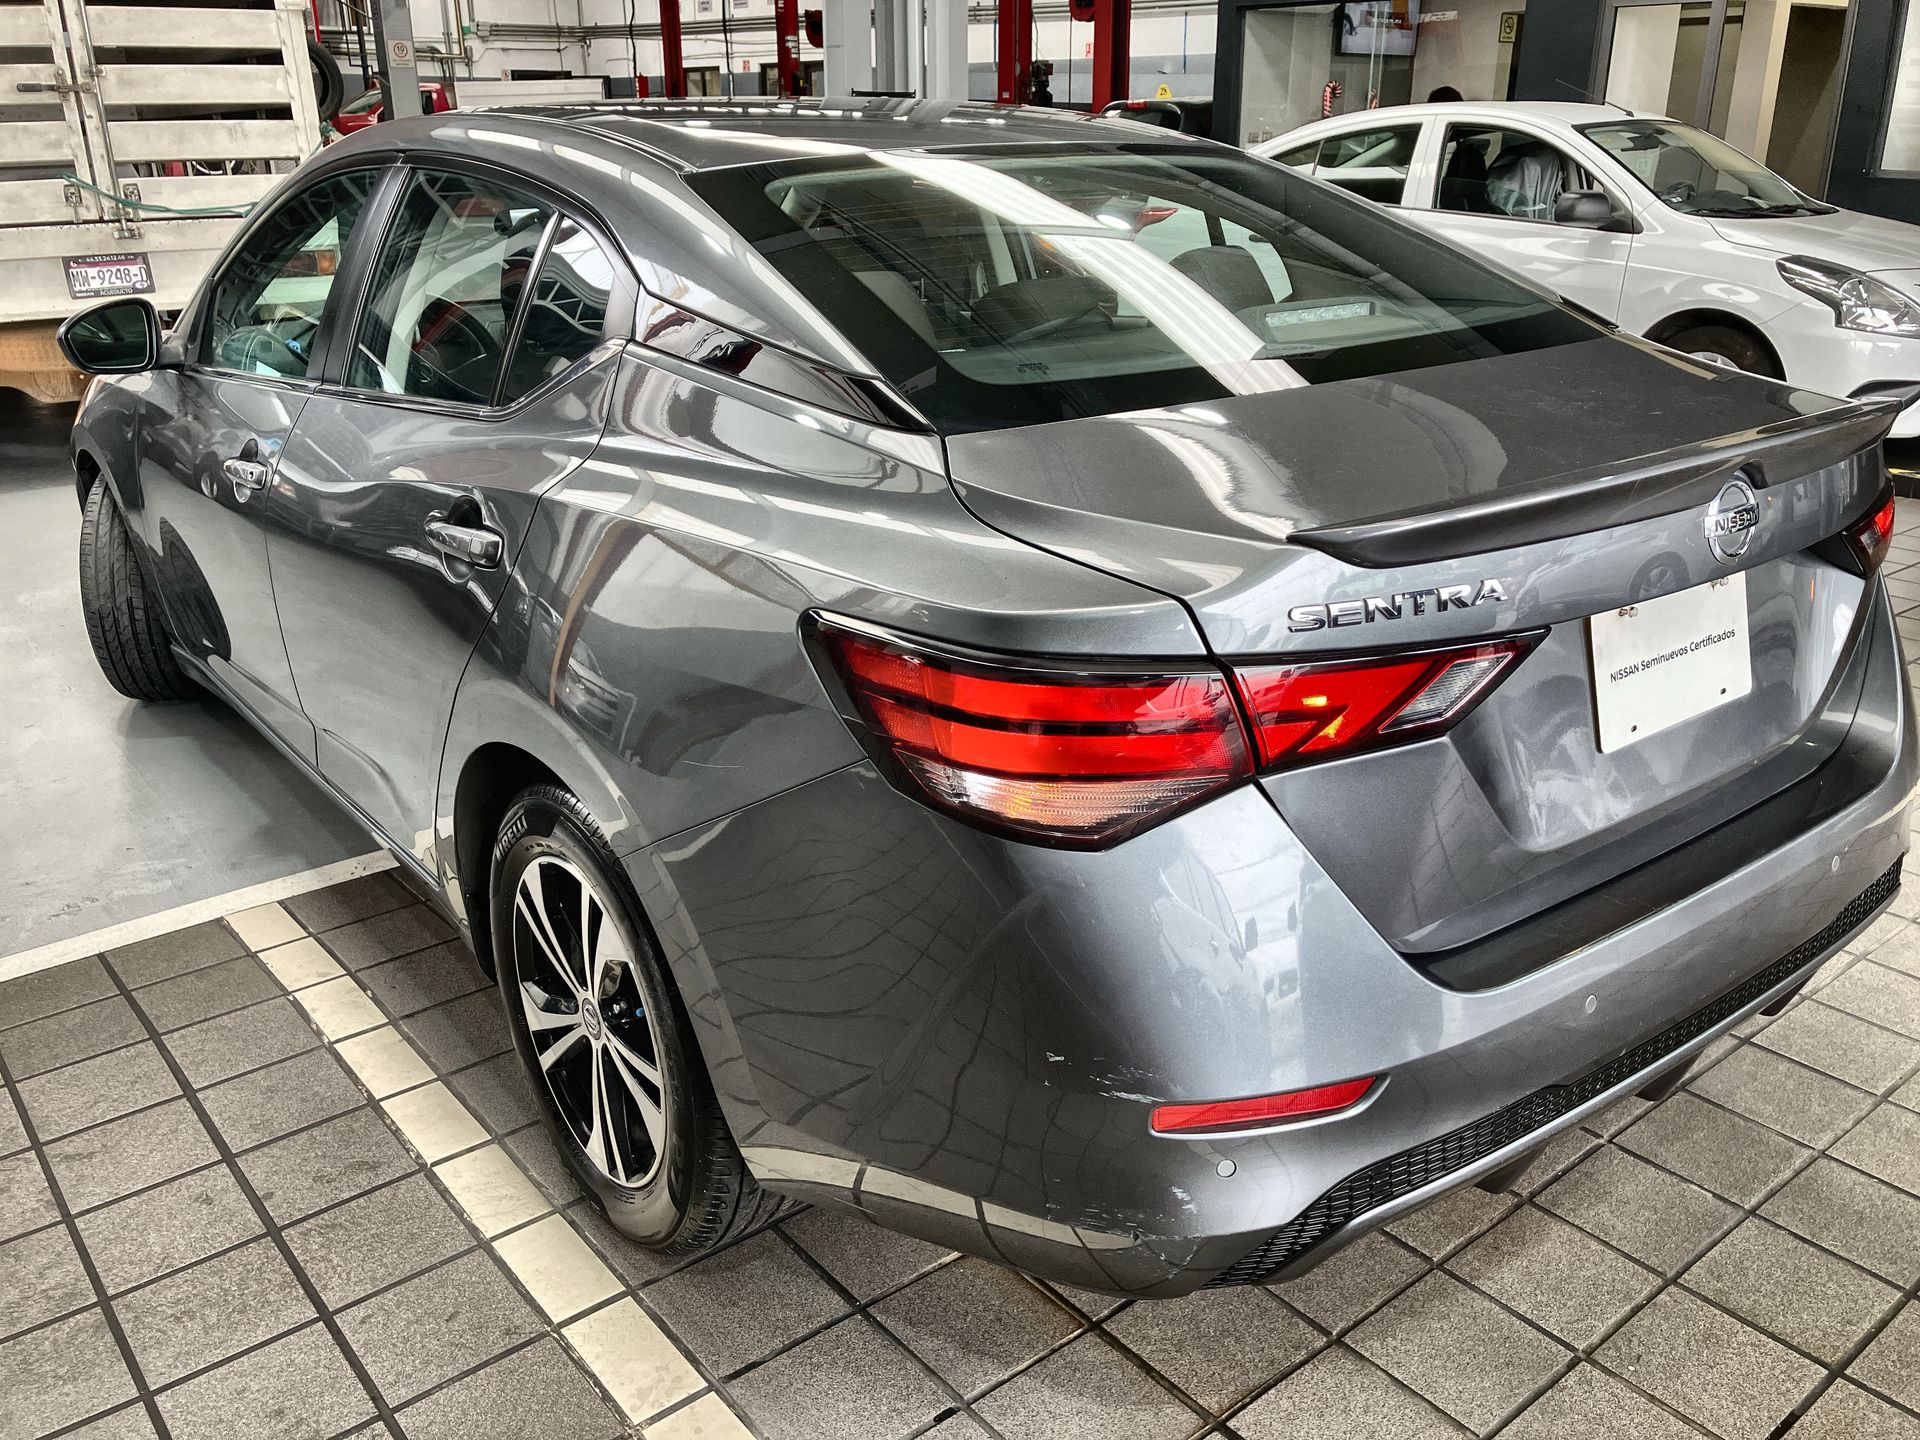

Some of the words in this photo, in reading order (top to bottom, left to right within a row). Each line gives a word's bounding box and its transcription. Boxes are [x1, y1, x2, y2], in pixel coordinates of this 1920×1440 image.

[1715, 508, 1758, 533] NISSAN
[1287, 577, 1509, 633] SENTRA
[1610, 663, 1640, 683] NISSAN
[1640, 645, 1688, 671] Seminuevos
[1689, 629, 1736, 652] Certificados
